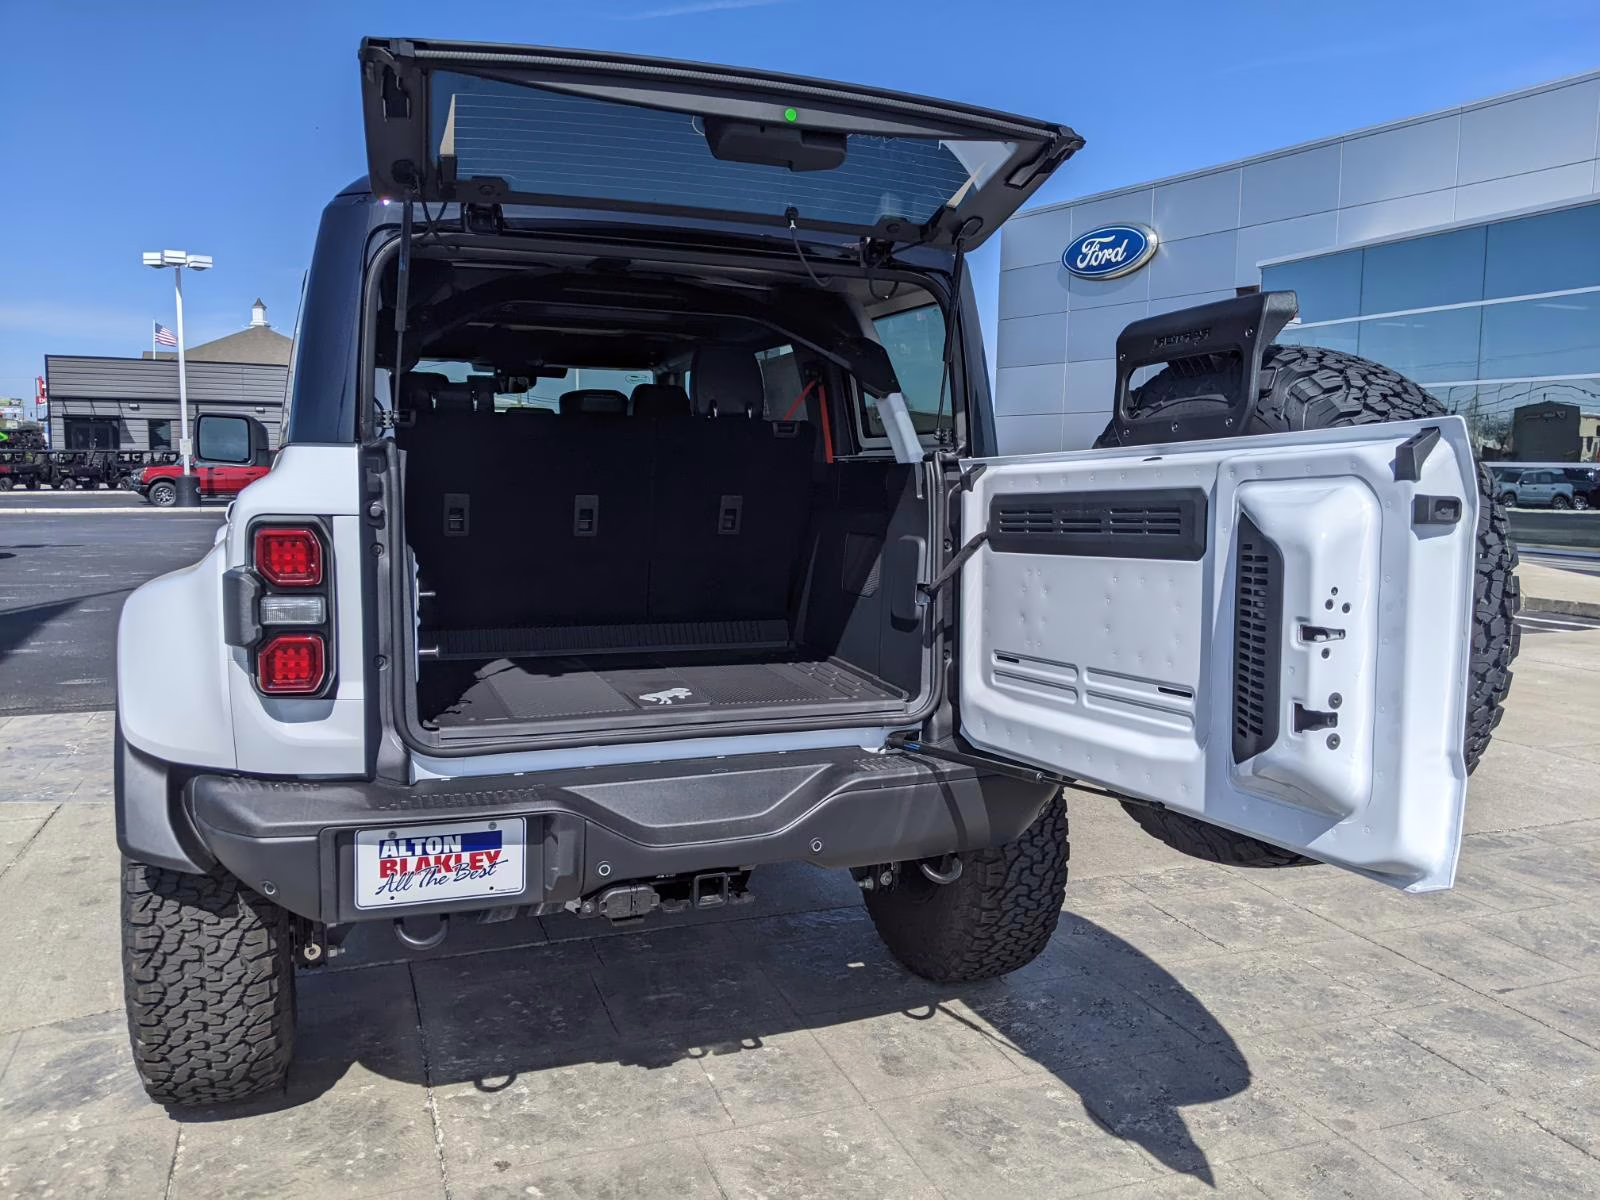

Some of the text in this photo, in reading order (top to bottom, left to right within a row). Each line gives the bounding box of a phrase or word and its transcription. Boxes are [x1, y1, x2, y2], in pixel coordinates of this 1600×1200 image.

[1076, 235, 1129, 269] Ford
[380, 835, 462, 859] ALTON
[374, 859, 509, 895] All The Best
[379, 850, 502, 879] BLAKLEY
